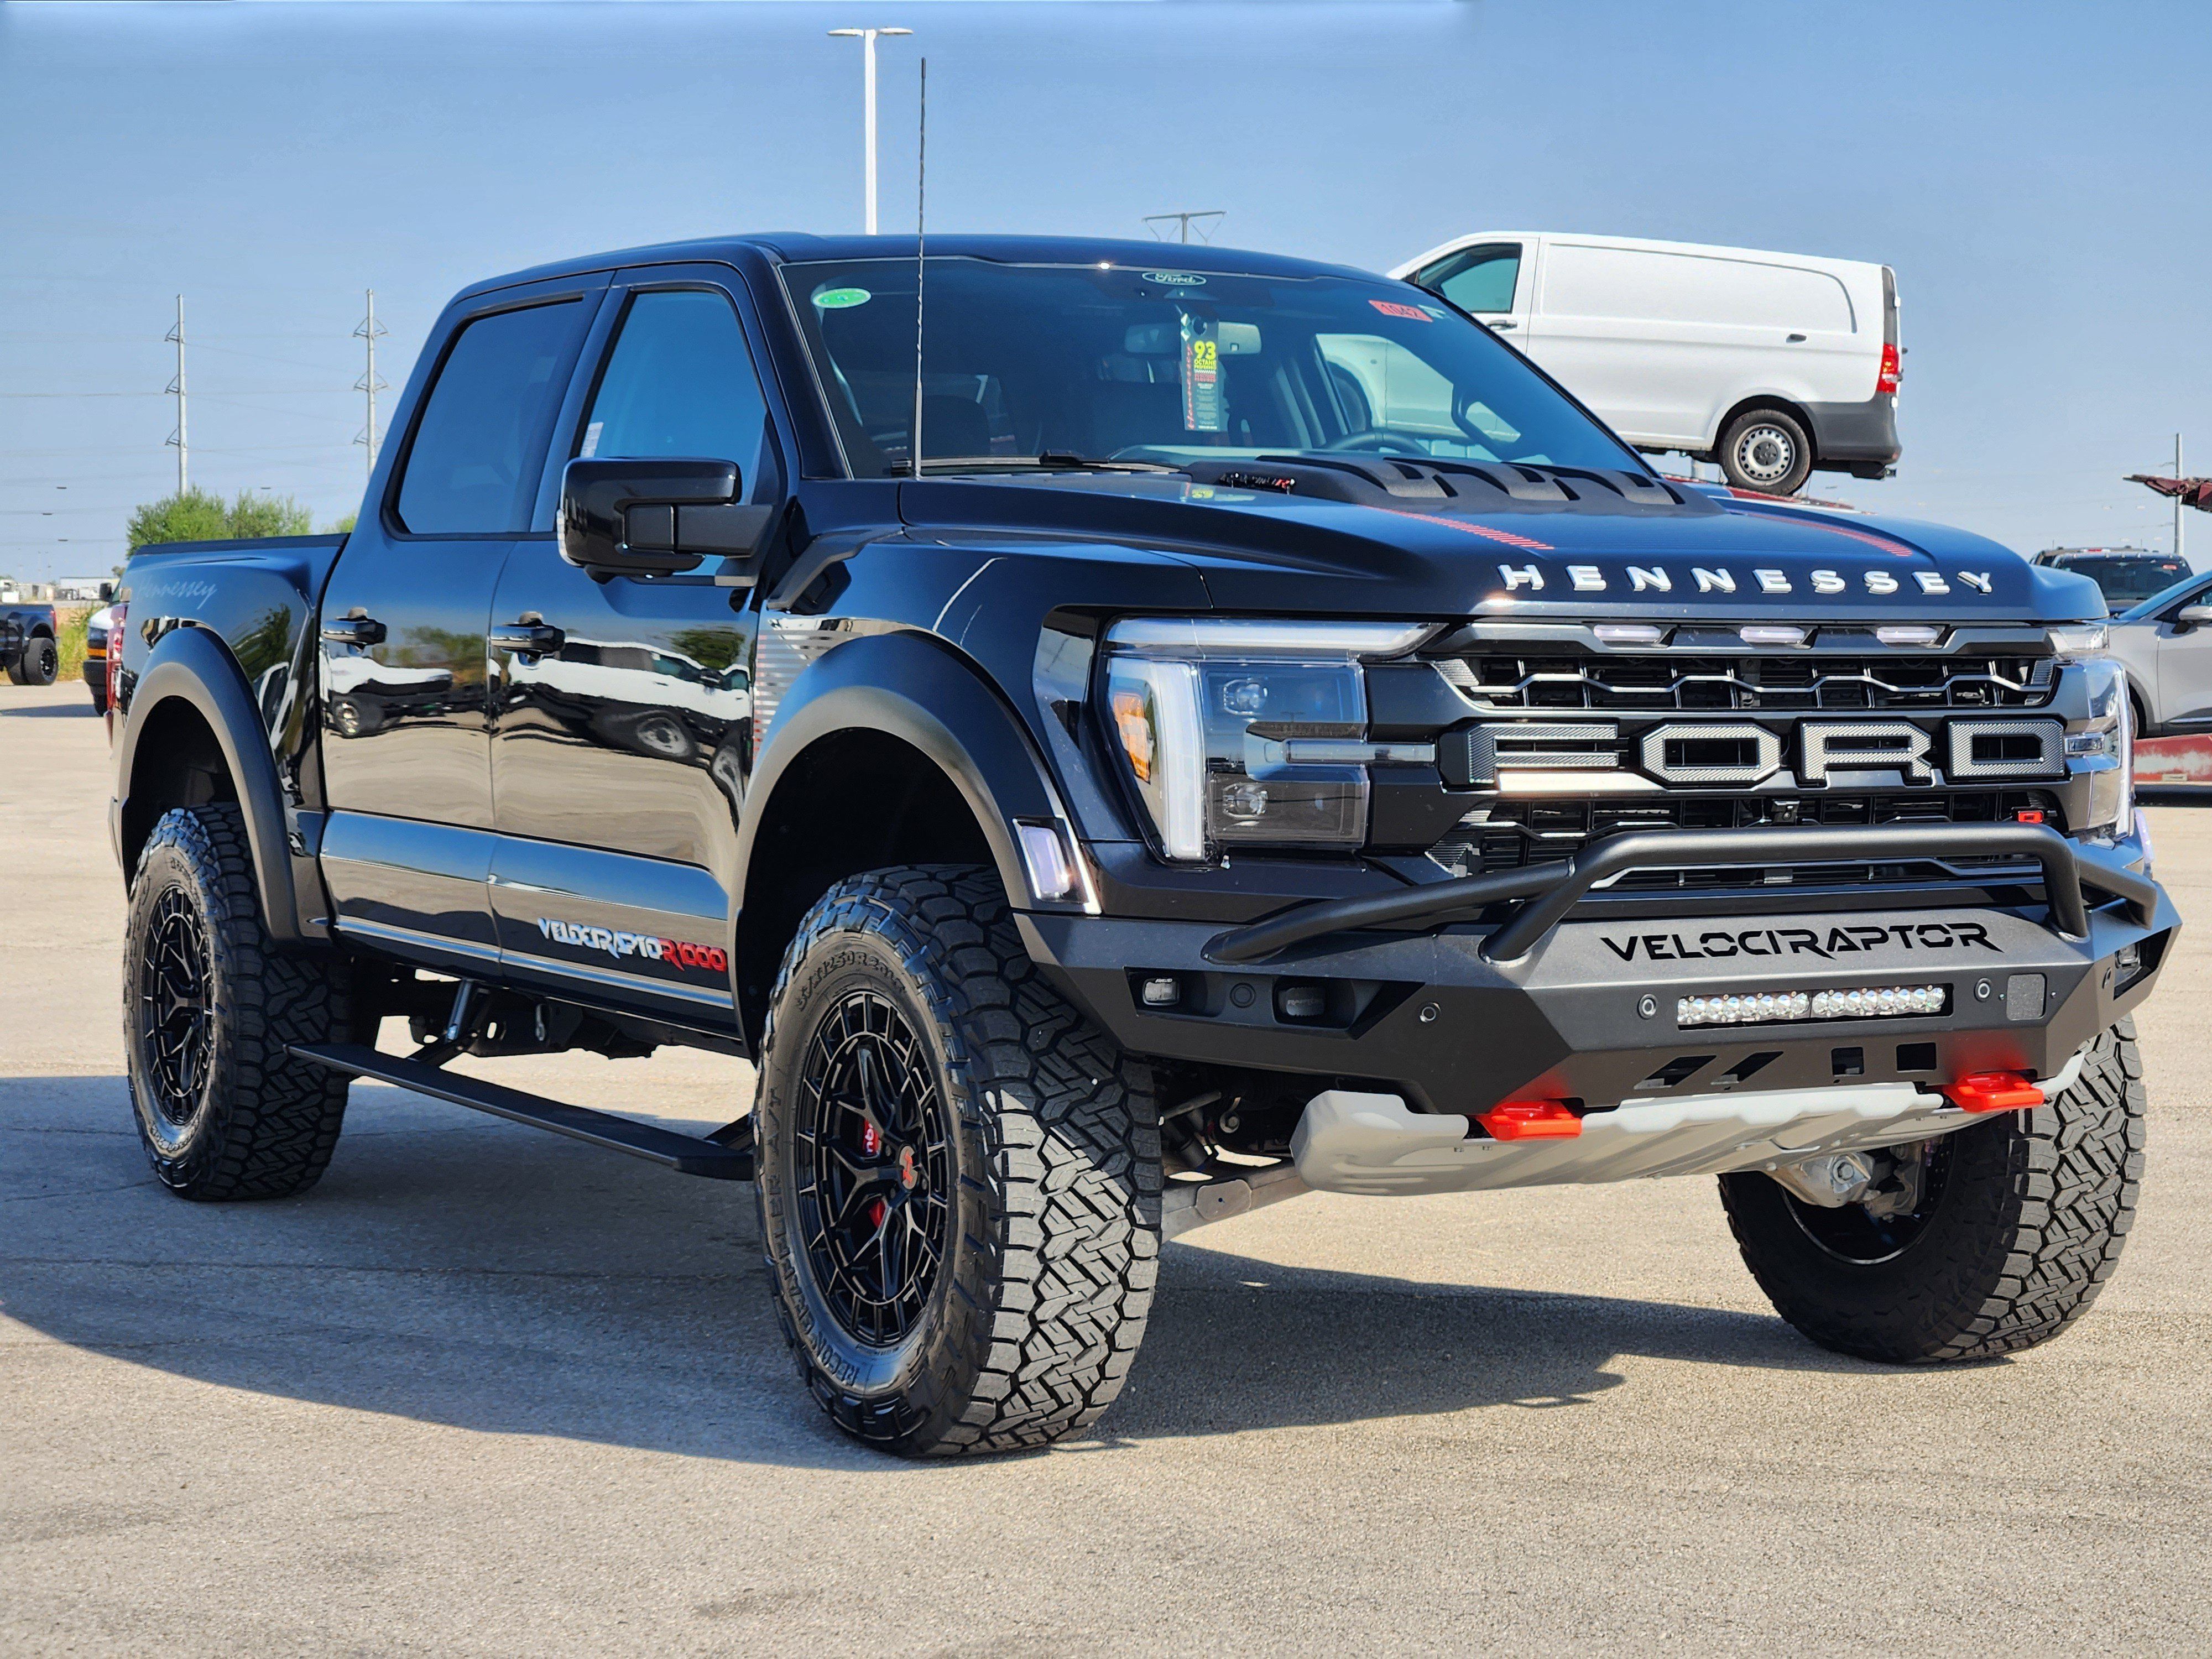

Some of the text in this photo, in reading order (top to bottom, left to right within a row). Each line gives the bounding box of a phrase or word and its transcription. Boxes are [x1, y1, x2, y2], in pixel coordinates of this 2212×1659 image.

[1155, 273, 1196, 283] Ford
[1194, 340, 1216, 359] 93
[1496, 564, 1992, 595] HENNESSEY
[1468, 722, 2065, 784] FORD
[1600, 921, 2005, 962] VELOCIRAPTOR
[810, 1331, 860, 1387] RECON
